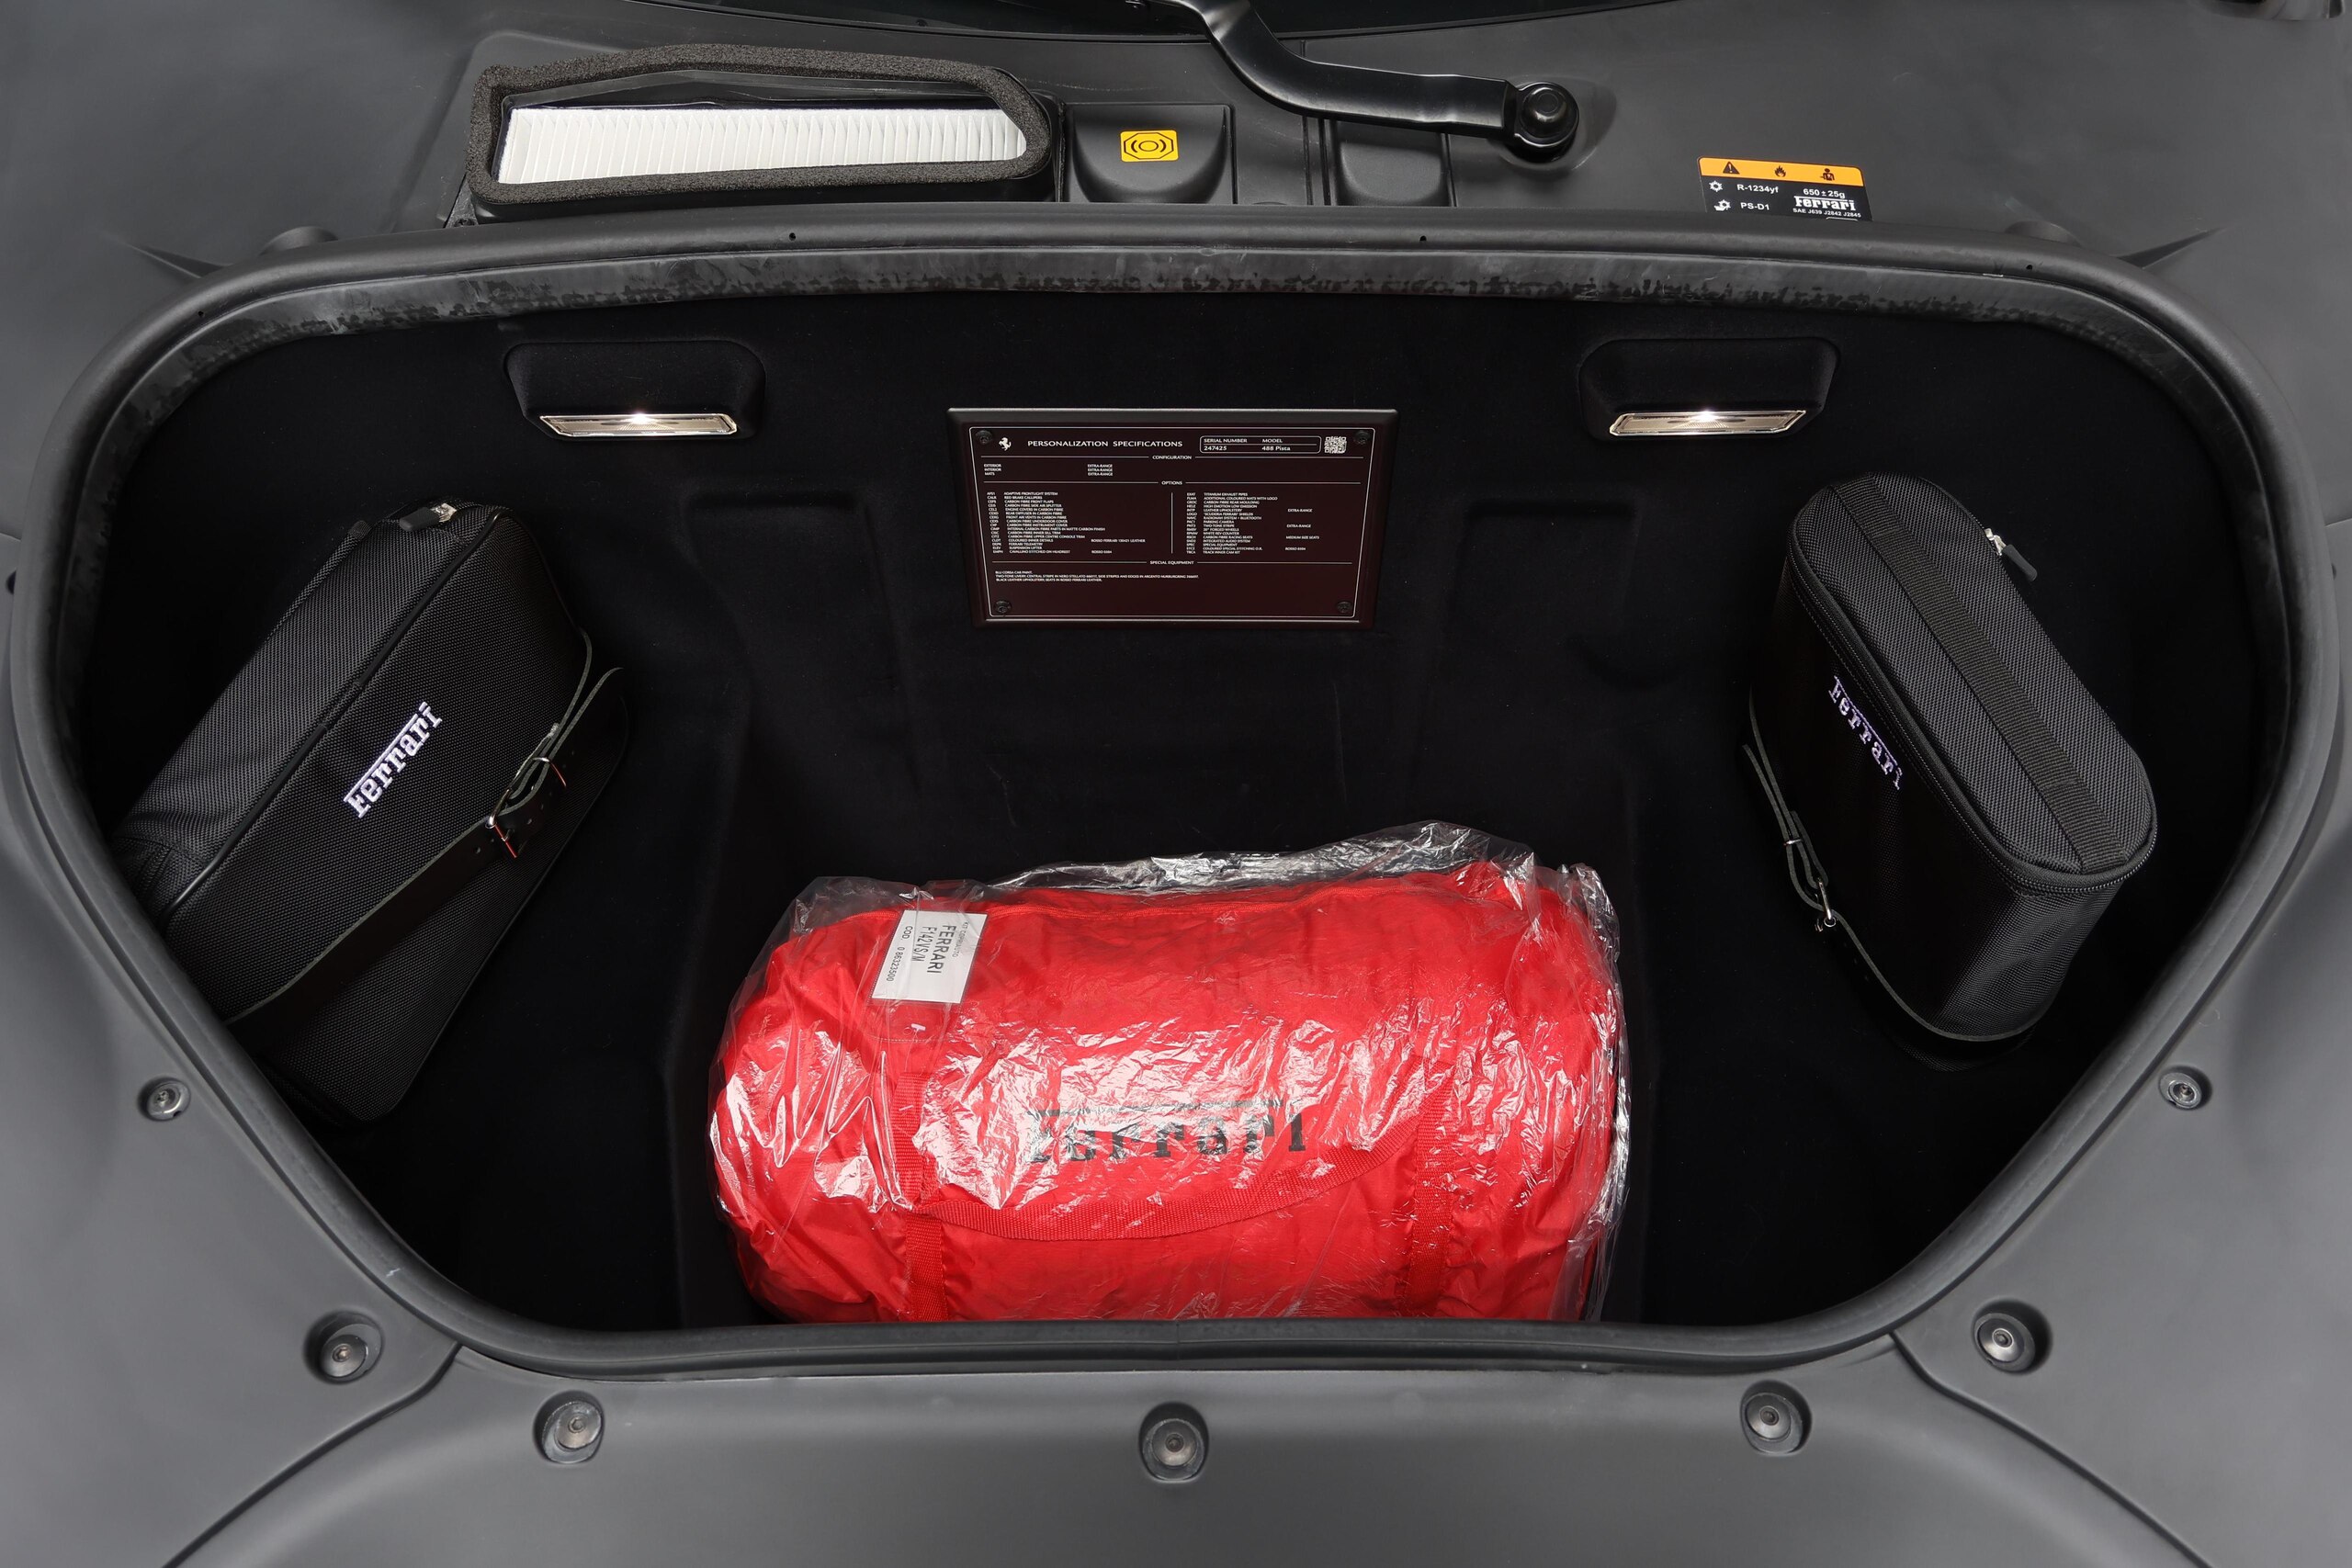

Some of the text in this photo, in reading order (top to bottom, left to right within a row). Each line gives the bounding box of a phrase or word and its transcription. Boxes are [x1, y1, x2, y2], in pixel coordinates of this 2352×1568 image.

[1736, 184, 1780, 194] R-1234yf
[1828, 190, 1846, 199] 25g
[1740, 202, 1770, 210] PS-D1
[1793, 196, 1856, 211] Ferrari
[1828, 675, 1903, 790] Ferrari
[343, 701, 443, 818] Ferrari
[900, 925, 913, 941] COD.
[926, 925, 957, 974] FERRARI
